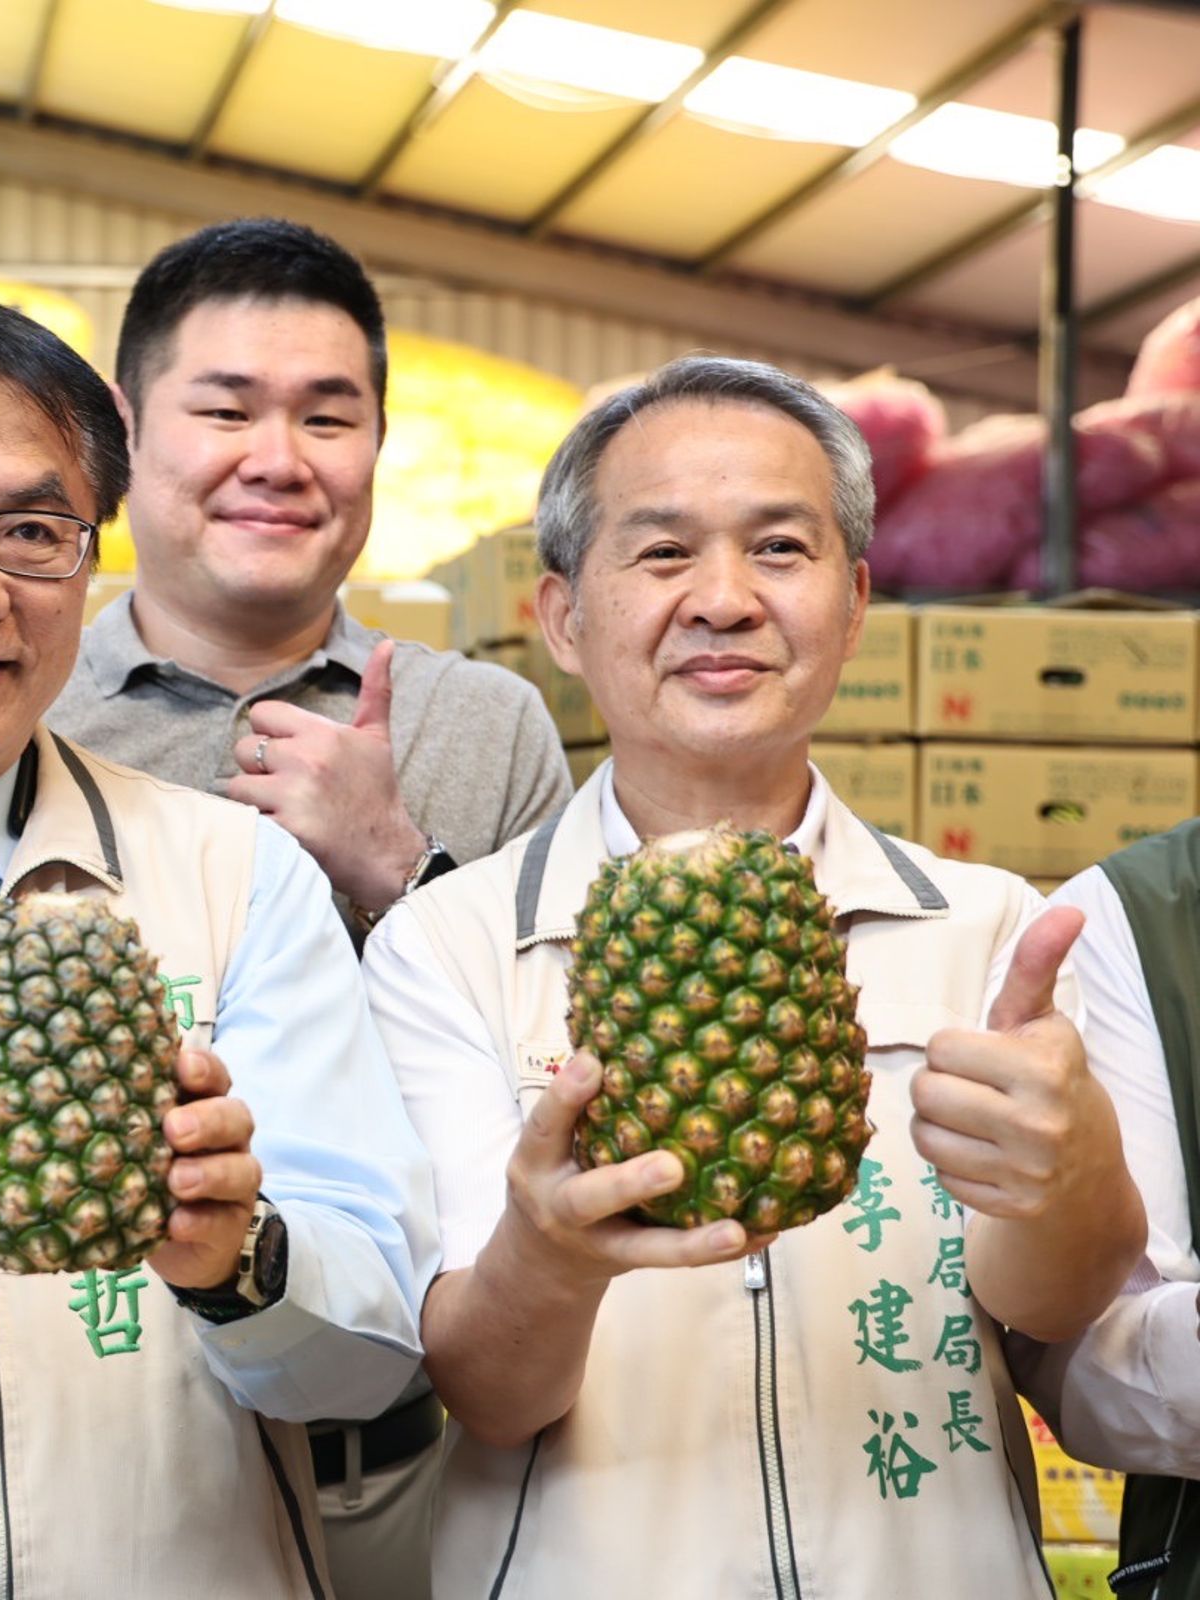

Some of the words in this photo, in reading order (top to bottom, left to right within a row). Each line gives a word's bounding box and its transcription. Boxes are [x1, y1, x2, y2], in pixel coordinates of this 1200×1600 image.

[942, 695, 972, 720] N
[943, 828, 972, 855] N
[68, 1265, 149, 1358] 哲
[843, 1157, 938, 1500] 李建裕
